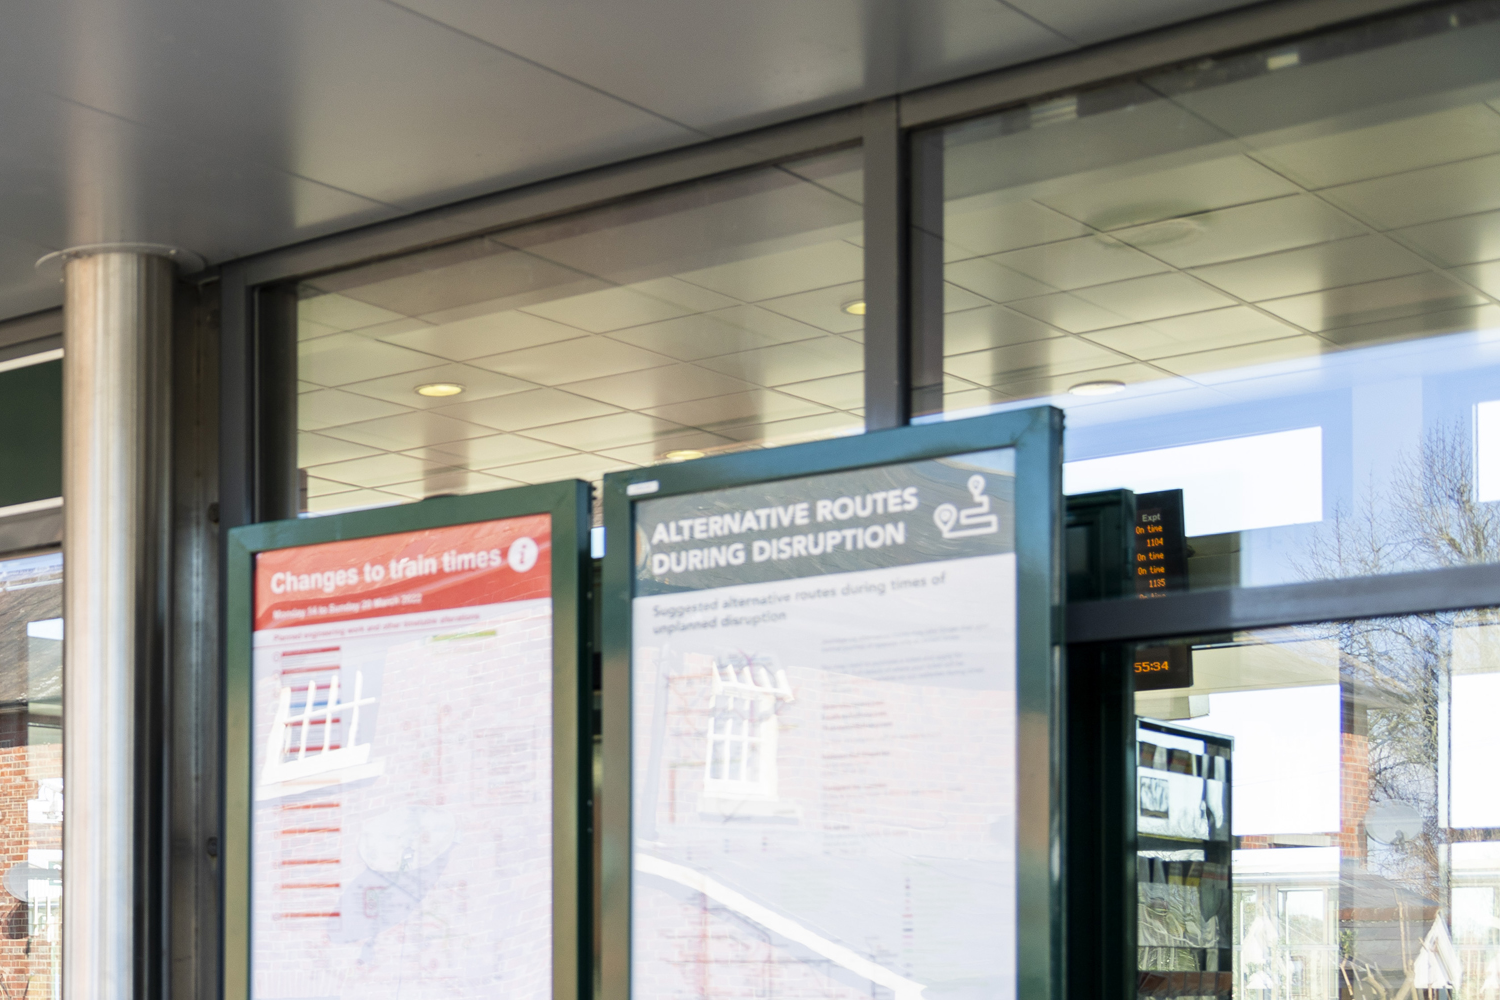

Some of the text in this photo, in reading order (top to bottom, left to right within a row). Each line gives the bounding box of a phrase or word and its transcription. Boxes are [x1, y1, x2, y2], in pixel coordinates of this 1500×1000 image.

[651, 487, 919, 545] ALTERNATIVE ROUTES
[1142, 512, 1161, 524] Expt
[1135, 523, 1163, 535] On time
[652, 522, 906, 576] DURING DISRUPTION
[1146, 537, 1164, 547] 1104
[1137, 550, 1165, 561] On time
[270, 547, 503, 594] Changes to train times
[1138, 564, 1165, 575] On time
[652, 570, 947, 619] Suggested alternative routes during times of
[652, 610, 787, 637] unplanned disruption
[1133, 660, 1169, 674] 55:34
